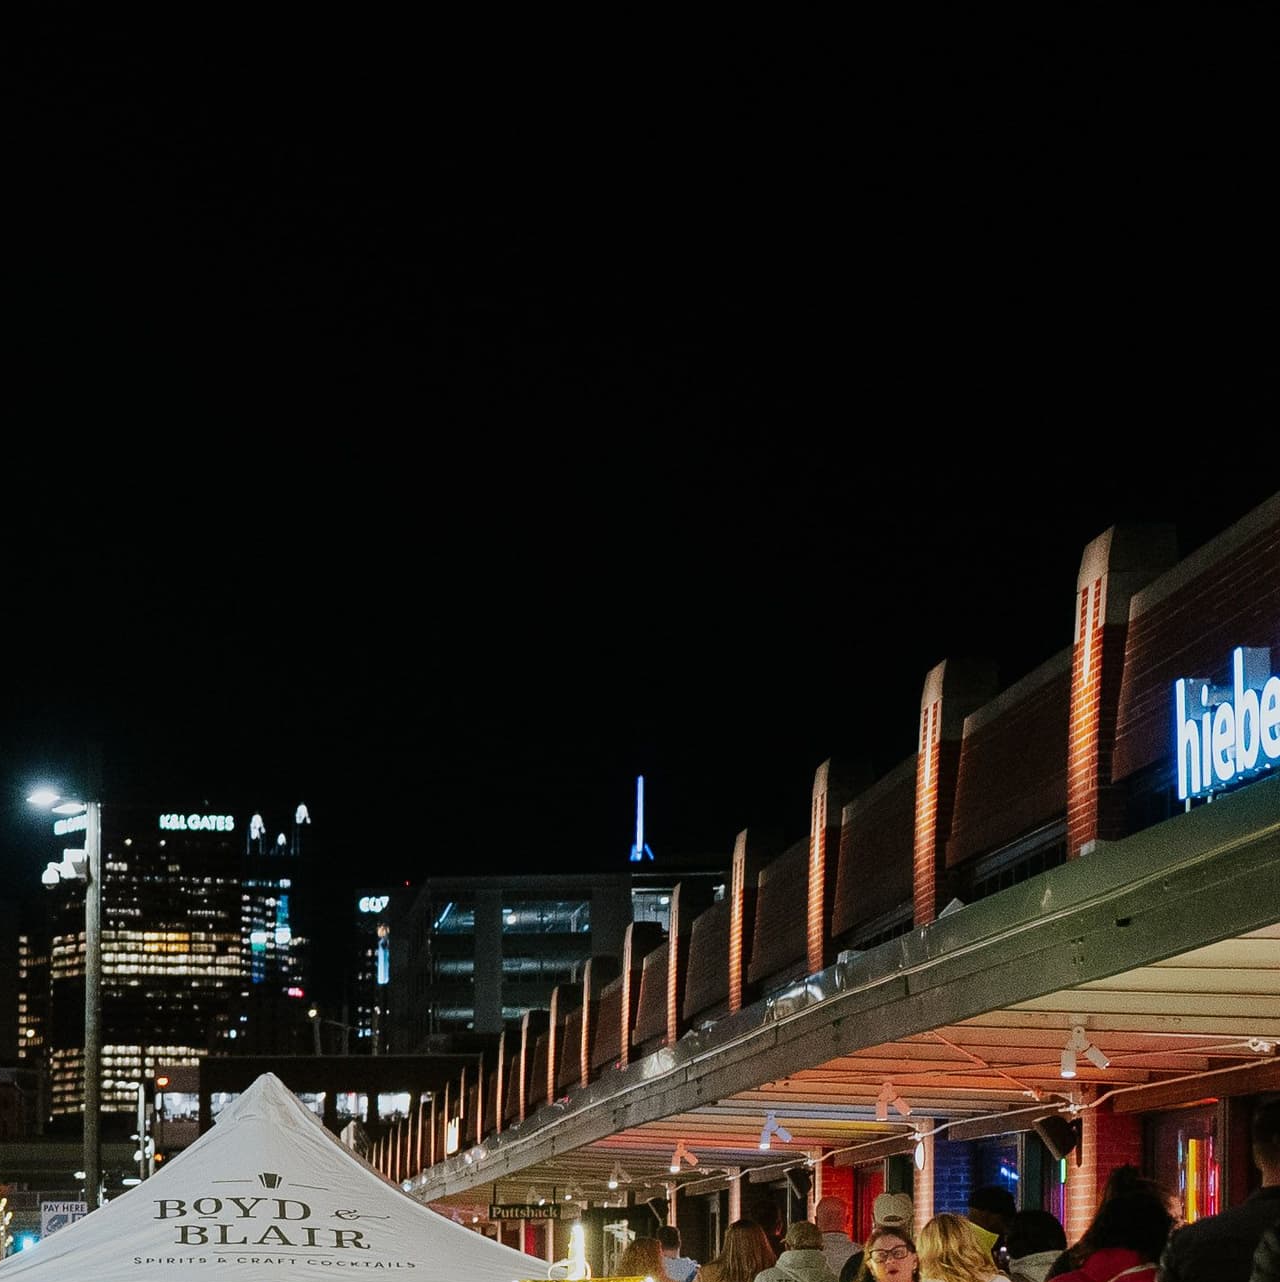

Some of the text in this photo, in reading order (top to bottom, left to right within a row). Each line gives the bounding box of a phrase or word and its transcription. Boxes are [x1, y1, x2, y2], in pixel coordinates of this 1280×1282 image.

[187, 813, 235, 831] GATES
[43, 1203, 86, 1212] PAY HERE
[153, 1197, 391, 1221] BOYD &
[492, 1206, 558, 1218] Puttshack
[173, 1223, 371, 1250] BLAIR
[133, 1256, 207, 1264] SPIRITS
[236, 1256, 297, 1266] CRAFT
[306, 1258, 416, 1269] COCKTAILS
